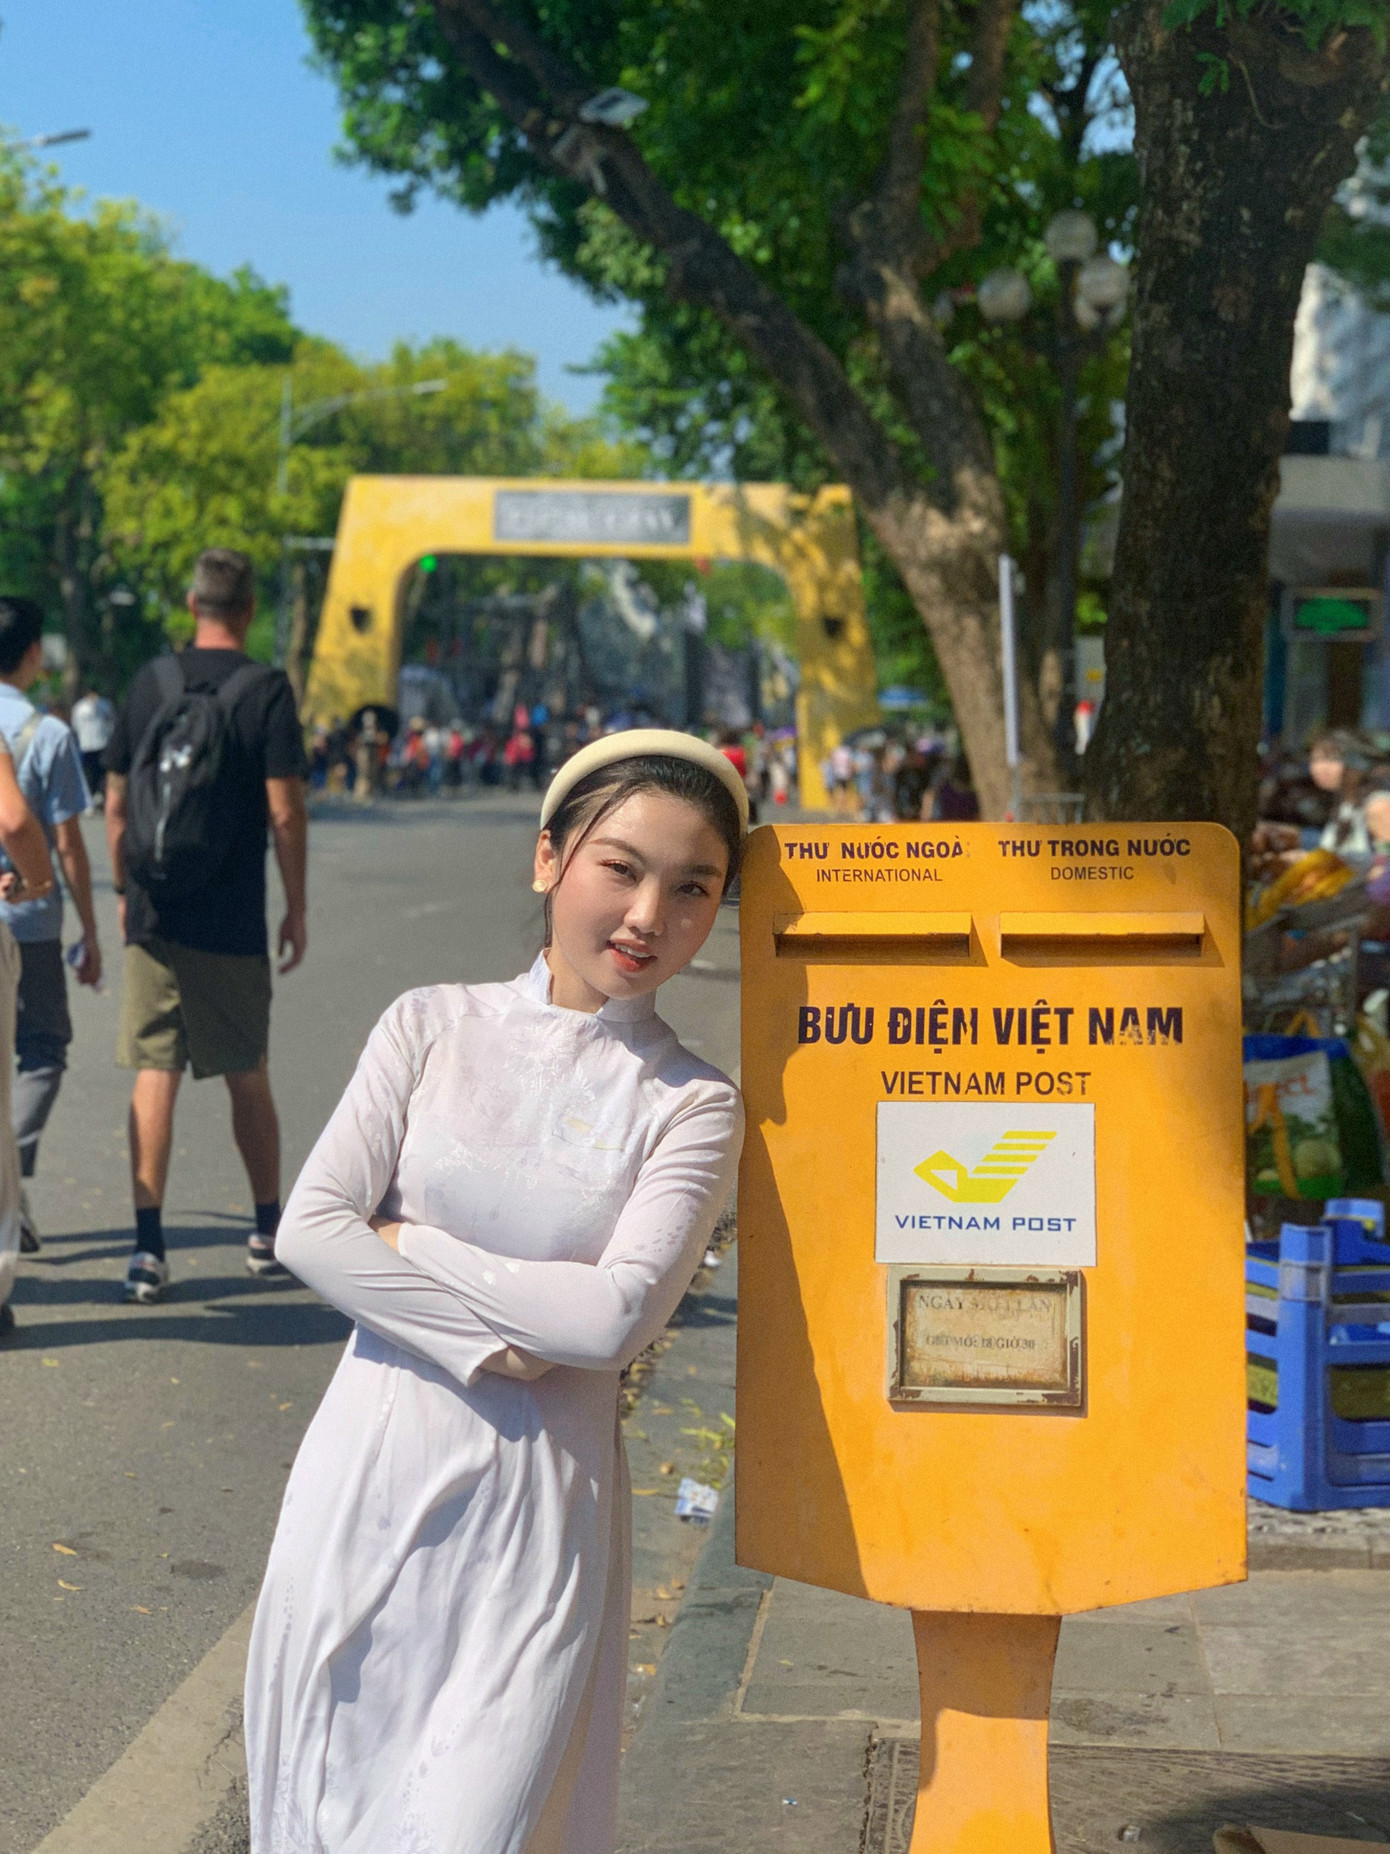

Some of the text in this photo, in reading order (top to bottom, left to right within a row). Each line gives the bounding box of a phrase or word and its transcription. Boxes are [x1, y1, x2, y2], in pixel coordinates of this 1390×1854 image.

[785, 841, 830, 859] THƯ
[842, 835, 899, 859] NƯỚC
[998, 832, 1191, 857] THƯ TRONG NƯỚC
[816, 868, 943, 883] INTERNATIONAL
[1051, 866, 1135, 881] DOMESTIC
[798, 998, 1184, 1054] BƯU ĐIỆN VIỆT NAM
[880, 1071, 1091, 1096] VIETNAM POST
[894, 1214, 1077, 1232] VIETNAM POST
